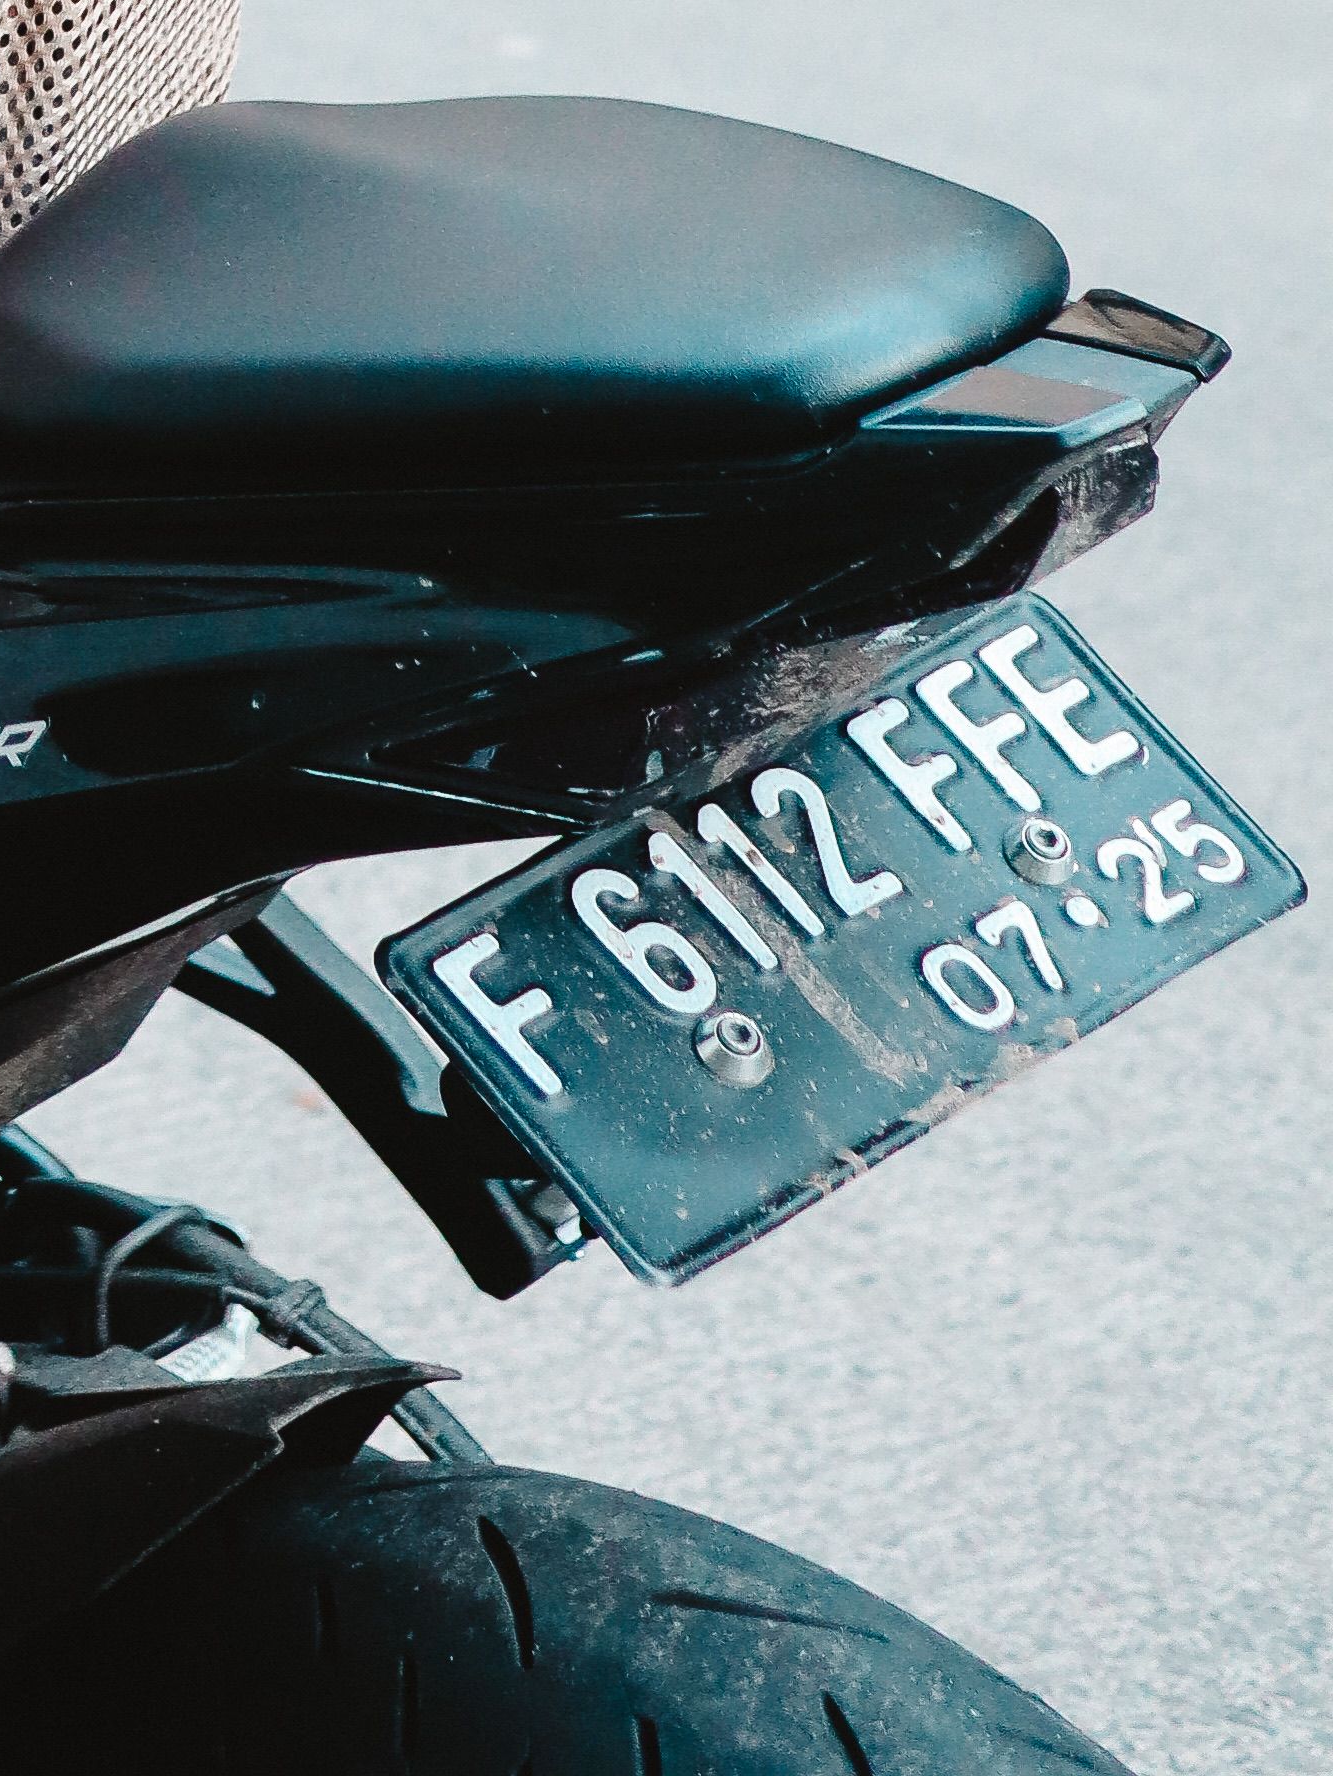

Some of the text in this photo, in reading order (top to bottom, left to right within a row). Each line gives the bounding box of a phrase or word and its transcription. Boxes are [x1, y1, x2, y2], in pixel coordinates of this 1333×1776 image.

[433, 623, 1140, 1098] F 6112 FFE
